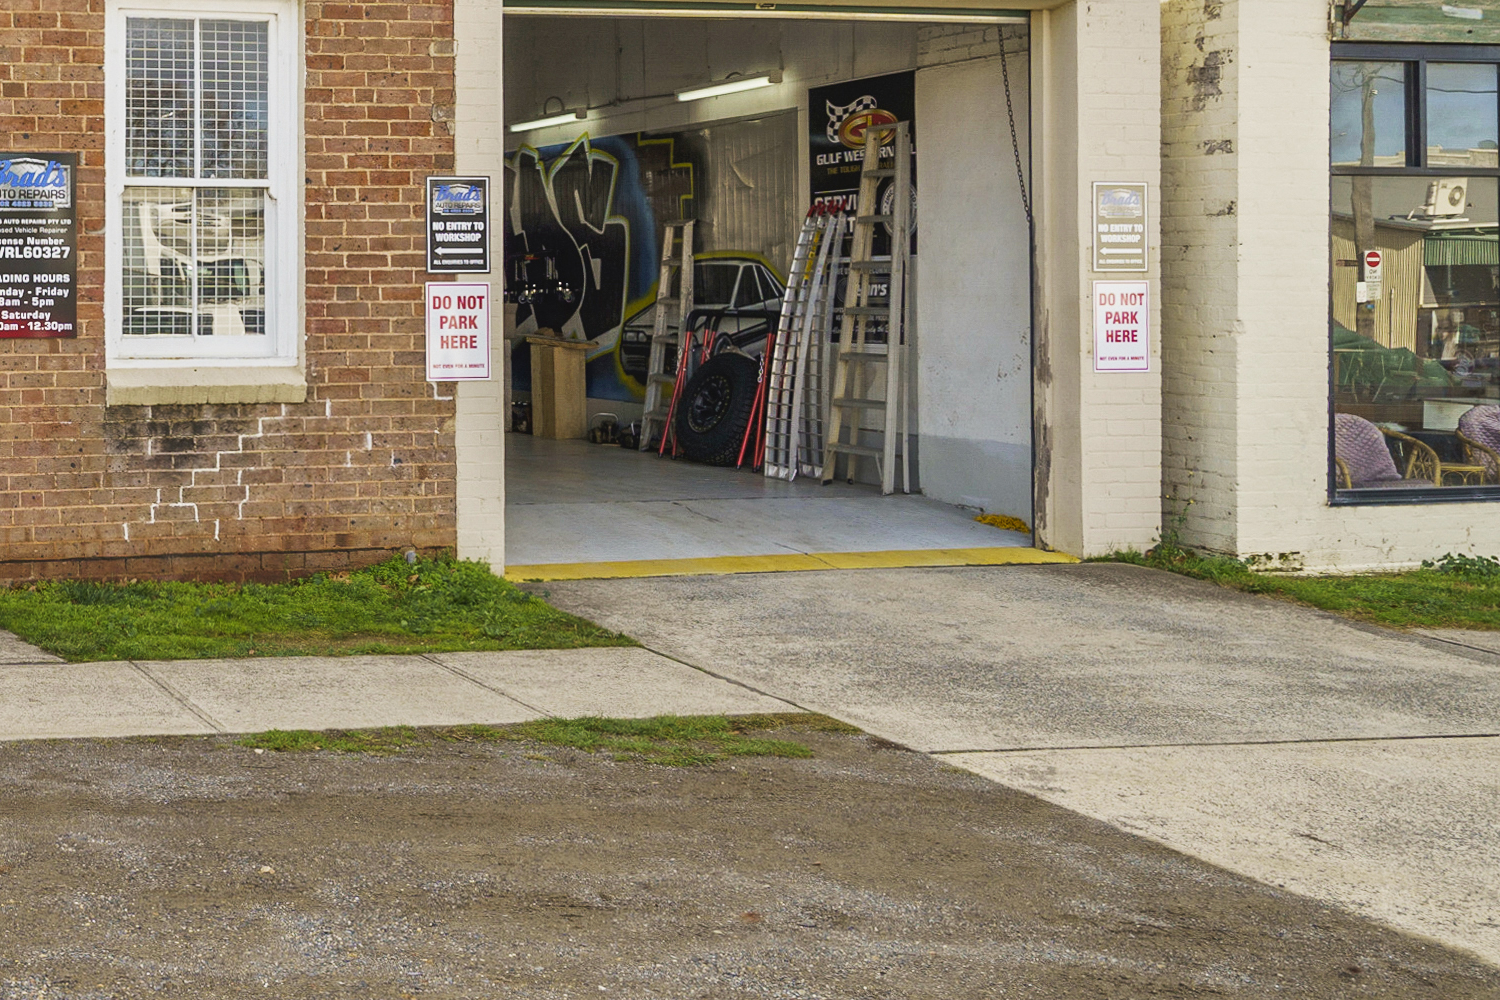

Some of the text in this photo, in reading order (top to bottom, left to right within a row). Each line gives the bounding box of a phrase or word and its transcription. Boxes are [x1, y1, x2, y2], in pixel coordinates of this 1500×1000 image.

[817, 152, 842, 165] GULF
[844, 146, 895, 162] WESRN
[19, 189, 66, 199] REPAIRS
[436, 185, 480, 201] Brad's
[1101, 190, 1139, 205] Brad's
[432, 222, 484, 230] NO ENTRY TO
[1098, 224, 1143, 232] NO ENTRY TO
[26, 237, 64, 245] Number
[435, 233, 481, 242] WORKSHOP
[1101, 234, 1141, 243] WORKSHOP
[33, 274, 70, 283] HOURS
[35, 287, 69, 298] Friday
[32, 297, 54, 308] 5pm
[433, 296, 485, 309] DO NOT
[1099, 293, 1144, 306] DO NOT
[1, 310, 51, 321] Saturday
[1105, 311, 1138, 324] PARK
[27, 321, 73, 332] 12.30pm
[440, 315, 478, 329] PARK
[440, 335, 477, 349] HERE
[1106, 330, 1138, 343] HERE
